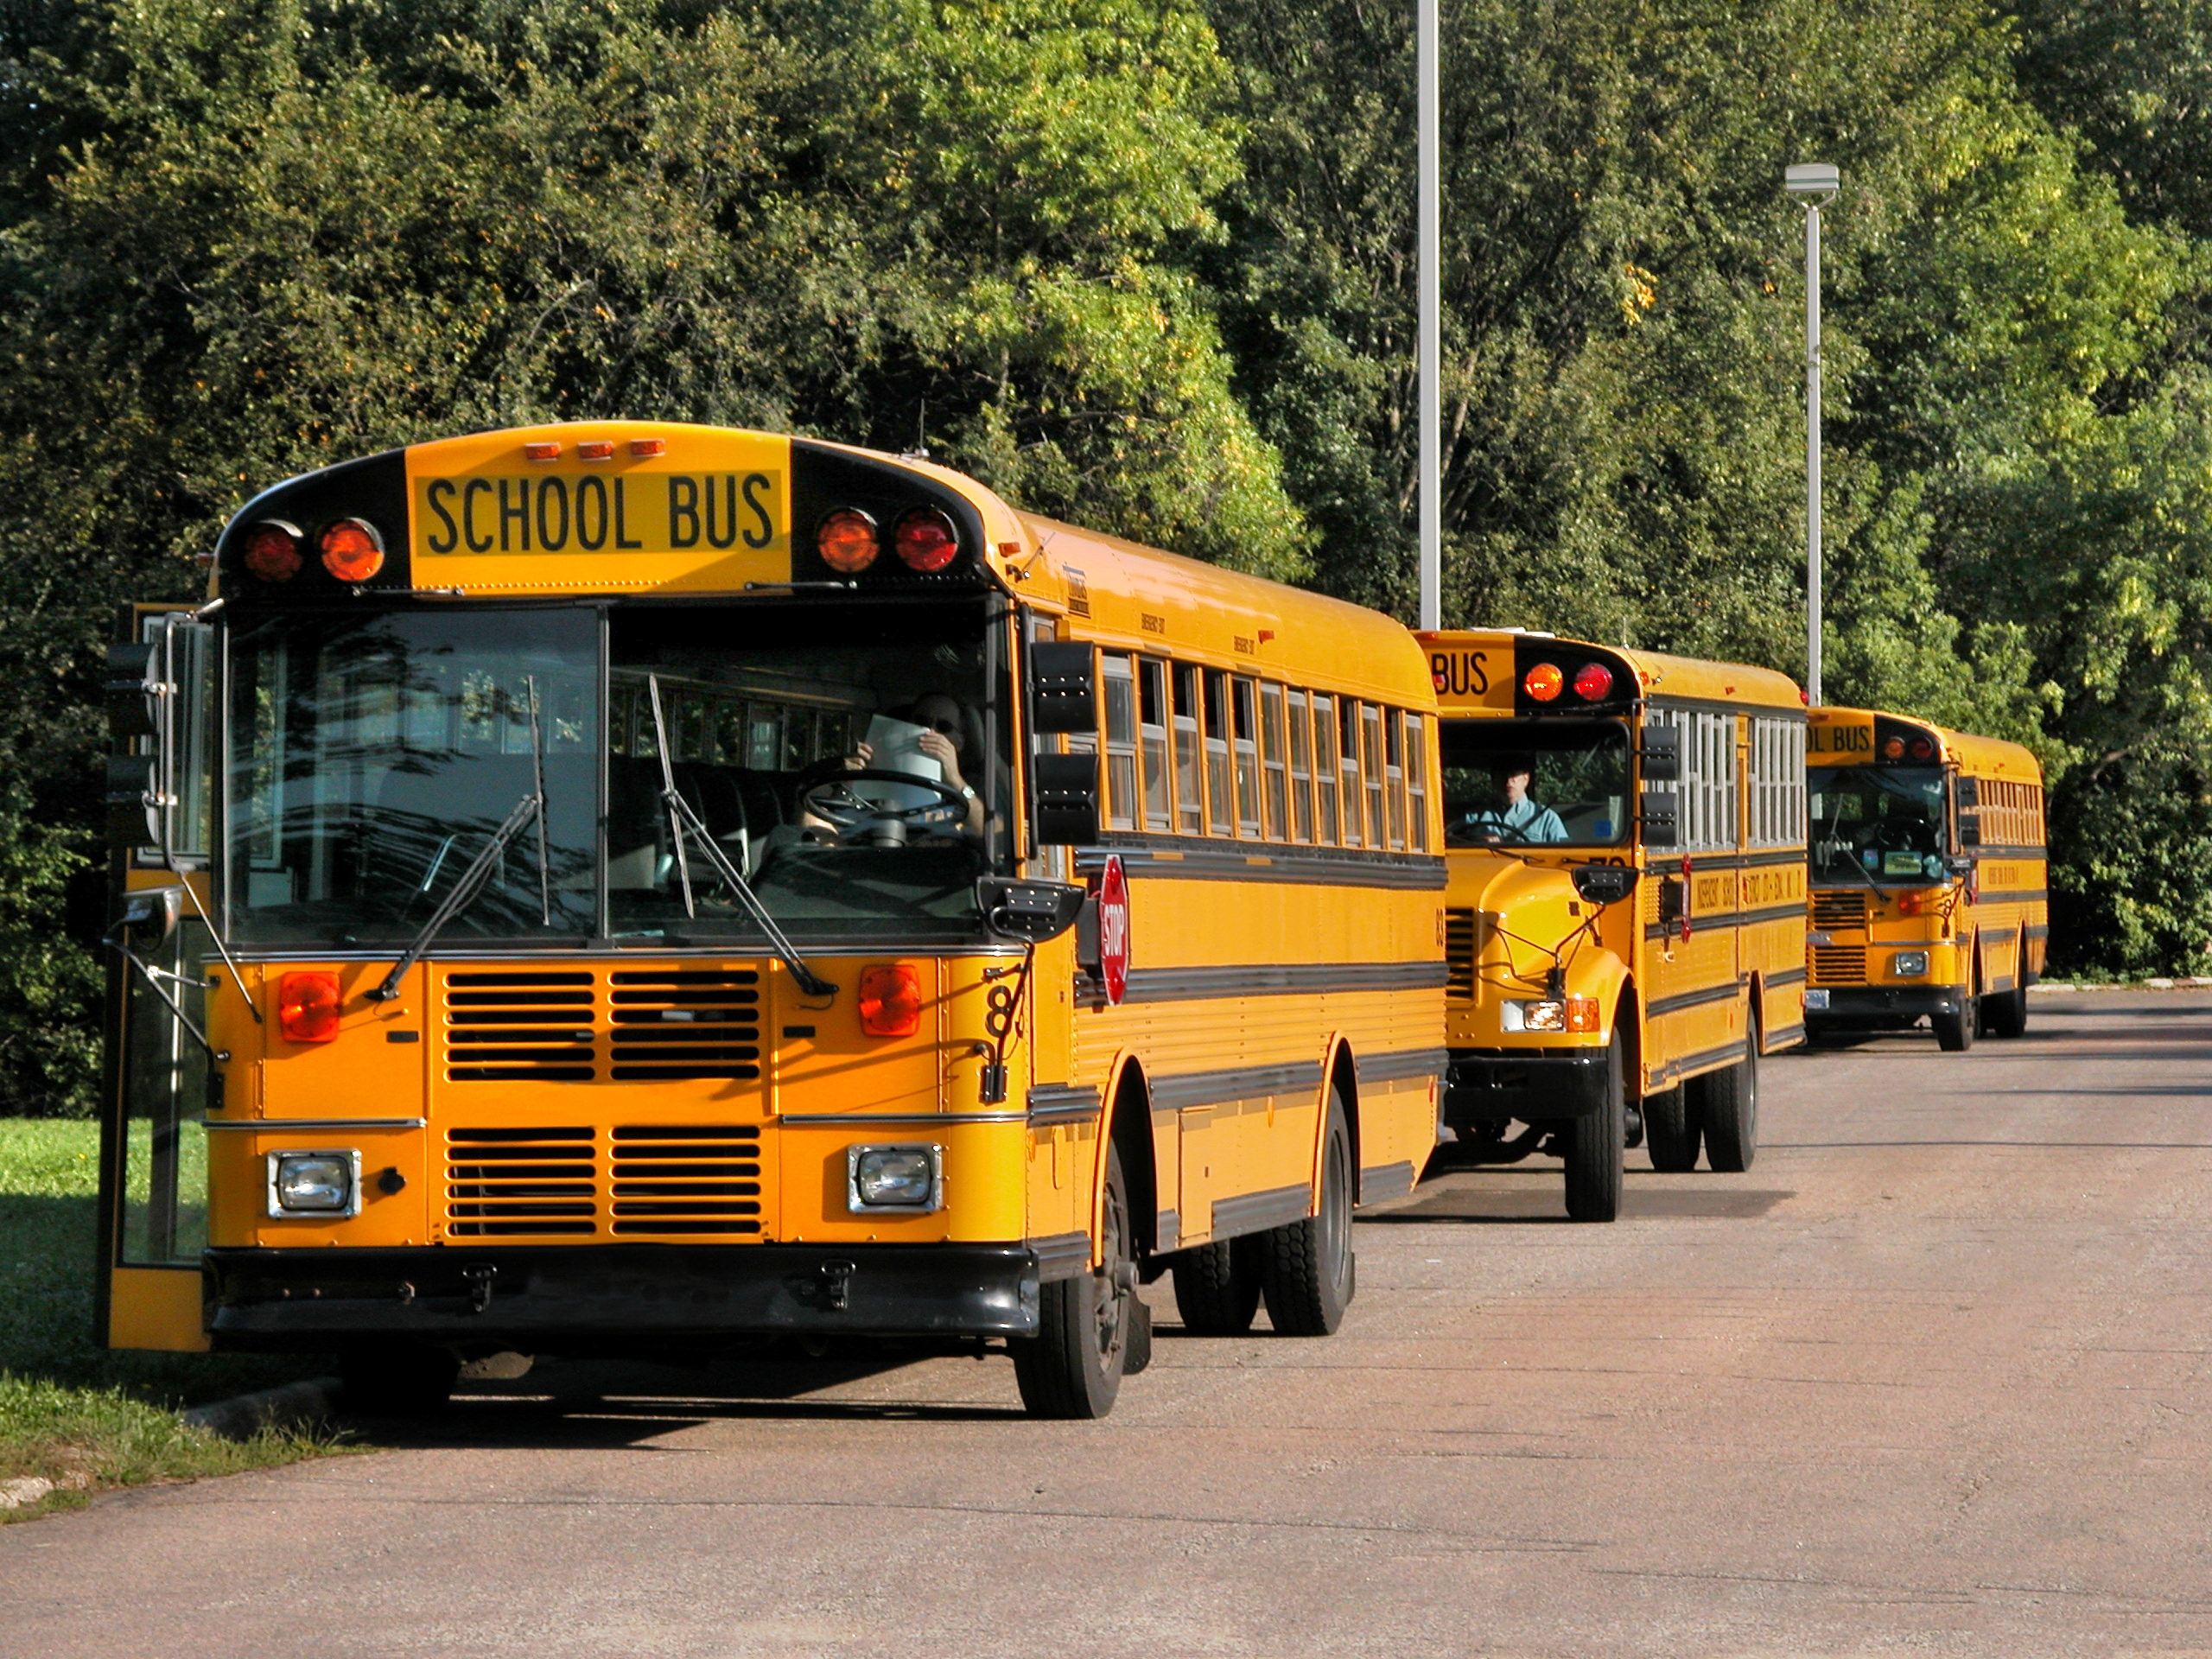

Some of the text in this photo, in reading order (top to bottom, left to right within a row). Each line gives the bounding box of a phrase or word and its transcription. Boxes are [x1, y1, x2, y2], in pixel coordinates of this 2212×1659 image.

[427, 473, 773, 554] SCHOOL BUS
[1431, 652, 1489, 696] BUS
[1833, 725, 1870, 753] BUS
[1104, 904, 1124, 957] STOP
